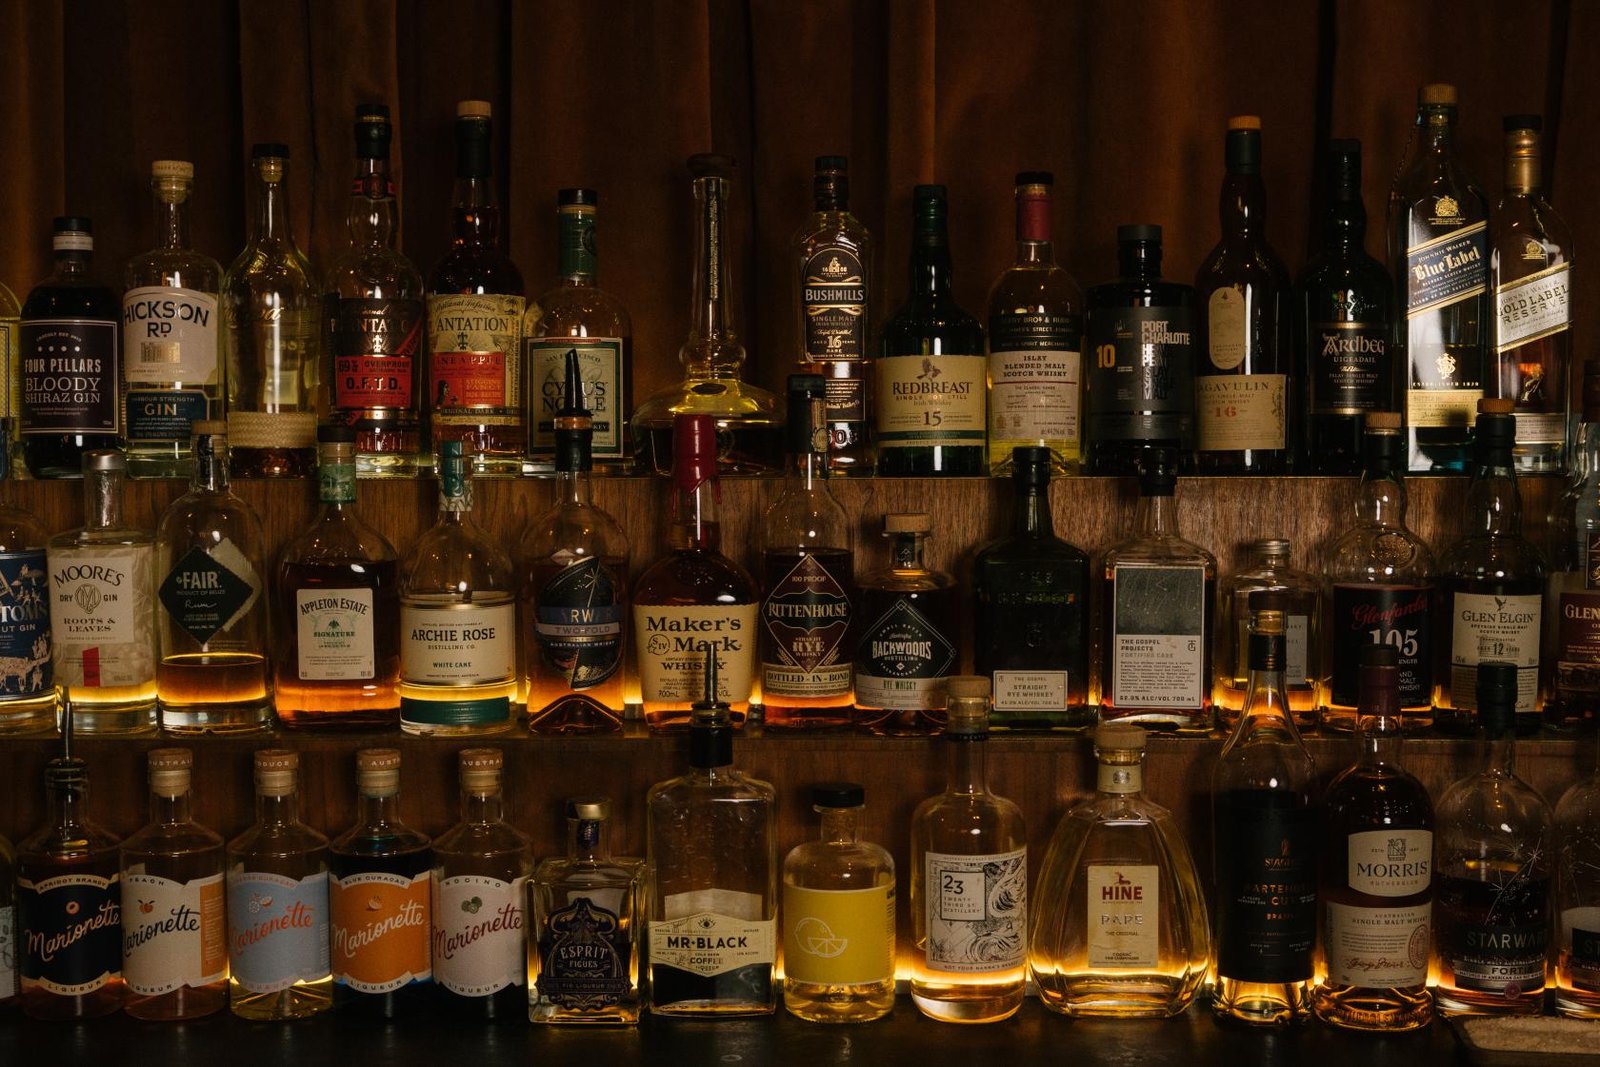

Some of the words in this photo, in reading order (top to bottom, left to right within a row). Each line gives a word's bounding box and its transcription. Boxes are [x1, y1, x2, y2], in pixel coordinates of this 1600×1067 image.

[1446, 240, 1471, 252] WALKER
[1412, 261, 1446, 283] Blue
[1443, 246, 1481, 271] Label
[805, 289, 864, 301] BUSHMILLS
[1529, 285, 1569, 306] LABEL
[1502, 296, 1566, 324] RESERVE
[436, 317, 509, 332] ANTATION
[1141, 320, 1169, 333] PORT
[827, 336, 842, 349] 16
[1141, 332, 1191, 345] CHARLOTTE
[1321, 333, 1385, 356] Ardbeg
[432, 356, 502, 366] INEAPPLE
[1096, 344, 1116, 369] 10
[25, 358, 45, 373] FOUR
[50, 358, 101, 373] PILLARS
[25, 376, 102, 392] BLOODY
[542, 381, 608, 397] CYUS
[892, 381, 973, 395] REDBREAST
[1197, 382, 1269, 392] AGAVULIN
[25, 392, 70, 404] SHIRAZ
[73, 392, 101, 404] GIN
[542, 397, 606, 412] NOLE
[144, 403, 177, 416] GIN
[1215, 407, 1237, 417] 16
[923, 411, 942, 426] 15
[54, 565, 125, 588] MOORE'S
[803, 575, 828, 583] PROOF
[59, 594, 73, 602] DRY
[103, 594, 118, 602] GIN
[300, 598, 338, 616] APPLETON
[340, 598, 368, 615] ESTATE
[768, 602, 848, 618] RITTENHOUSE
[646, 616, 741, 631] Maker's
[1462, 610, 1496, 623] GLEN
[1499, 612, 1534, 624] ELGIN
[19, 623, 36, 632] GIN
[411, 629, 458, 642] ARCHIE
[462, 628, 496, 641] ROSE
[792, 641, 825, 652] RYE
[1369, 629, 1418, 657] 105
[1493, 642, 1504, 655] 12
[872, 640, 932, 661] BACKWOODS
[661, 661, 728, 671] WHISY
[895, 680, 917, 690] WHISKY
[1357, 861, 1427, 877] MORRIS
[76, 877, 106, 888] BRANDY
[129, 877, 165, 886] PEACH
[344, 876, 362, 886] BLUE
[943, 875, 964, 895] 23
[1102, 886, 1143, 900] HINE
[24, 899, 121, 962] Marionette
[333, 899, 425, 958] Marionette
[433, 903, 524, 961] Marionette
[559, 945, 609, 960] ESPRIT
[569, 960, 599, 968] FIGUES
[48, 981, 102, 993] LIQUEUR
[129, 983, 173, 995] IQUEUR
[350, 979, 403, 992] LIQUEUR
[447, 981, 501, 993] LIQUEUR
